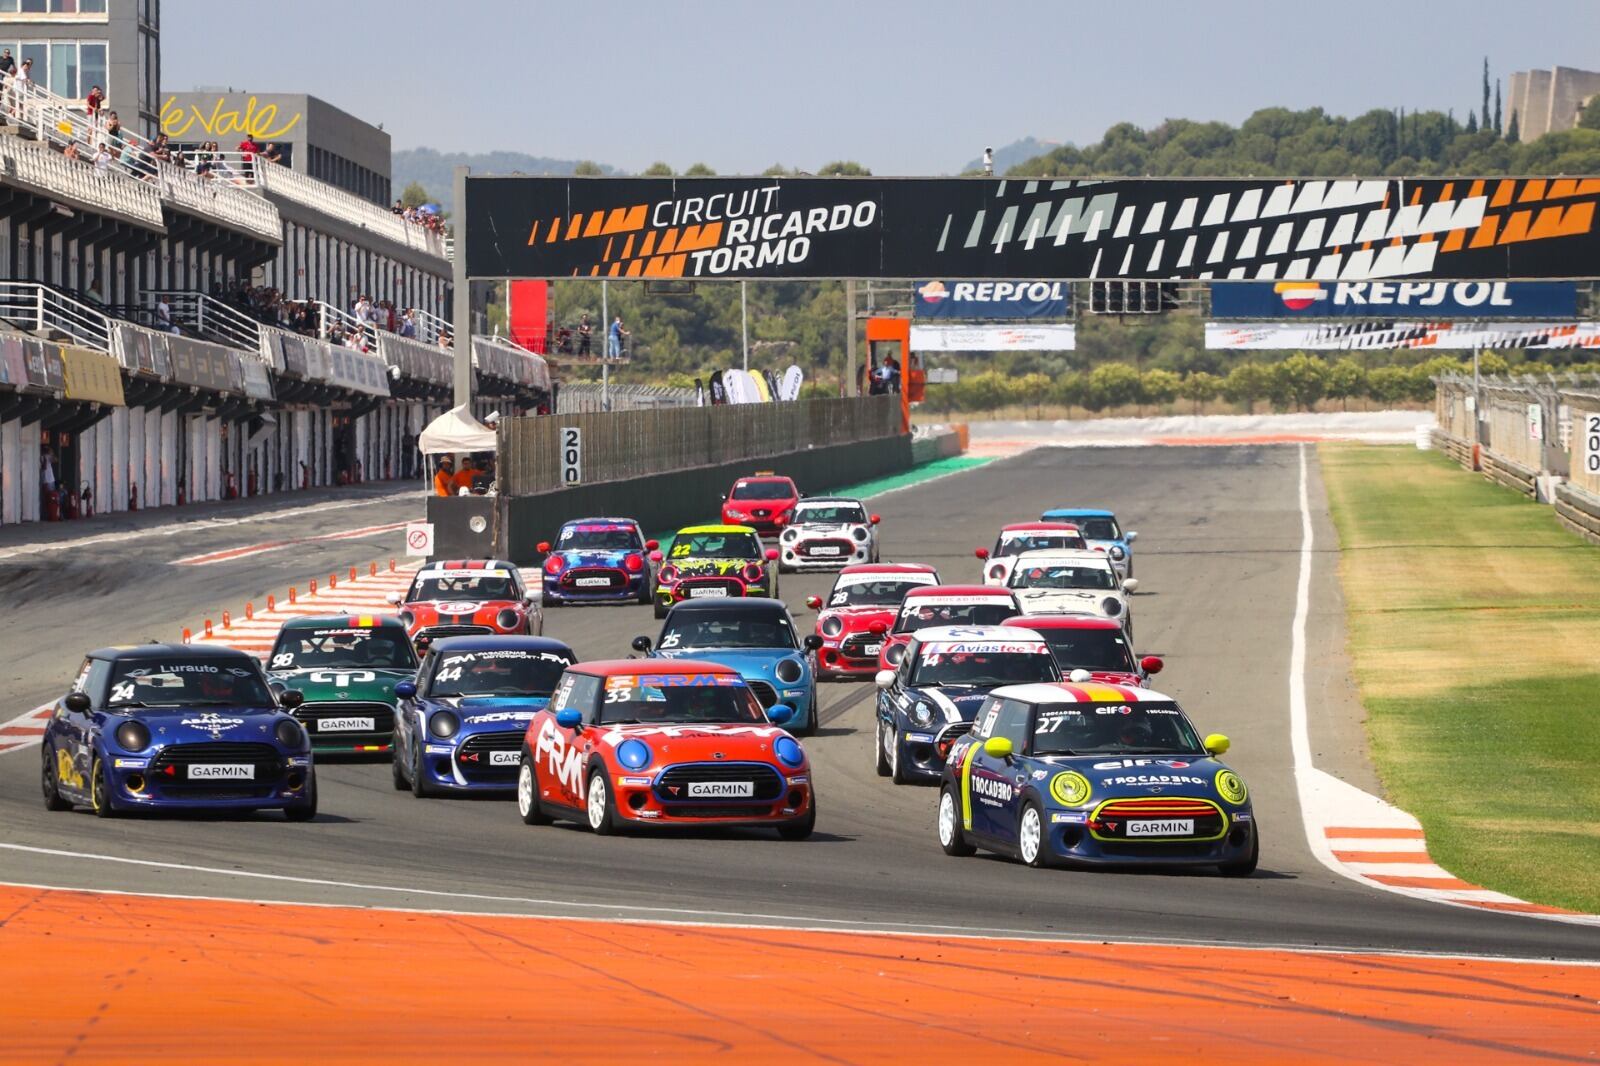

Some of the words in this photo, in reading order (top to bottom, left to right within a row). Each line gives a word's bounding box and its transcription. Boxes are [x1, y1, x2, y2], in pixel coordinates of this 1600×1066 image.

[653, 186, 780, 227] CIRCUIT
[726, 201, 876, 246] RICARDO
[691, 237, 810, 276] TORMO
[953, 282, 1063, 302] REPSOL
[1333, 281, 1513, 306] REPSOL
[1589, 417, 1600, 471] 200
[565, 430, 578, 482] 200
[672, 544, 691, 557] 22
[831, 592, 848, 605] 28
[902, 605, 921, 617] 64
[660, 634, 682, 648] 25
[955, 644, 1025, 653] Aviastec
[272, 652, 294, 668] 98
[922, 654, 939, 667] 14
[160, 664, 219, 674] Lurauto
[436, 666, 462, 682] 44
[639, 675, 717, 686] PRM
[109, 685, 135, 702] 24
[605, 688, 631, 703] 33
[1096, 706, 1118, 714] elf
[320, 721, 370, 729] GARMIN
[1035, 717, 1064, 734] 27
[494, 754, 520, 763] GAR
[535, 718, 585, 800] PRM
[1093, 759, 1152, 770] elf
[192, 767, 248, 777] GARMIN
[692, 785, 748, 795] GARMIN
[1130, 822, 1191, 833] GARMIN
